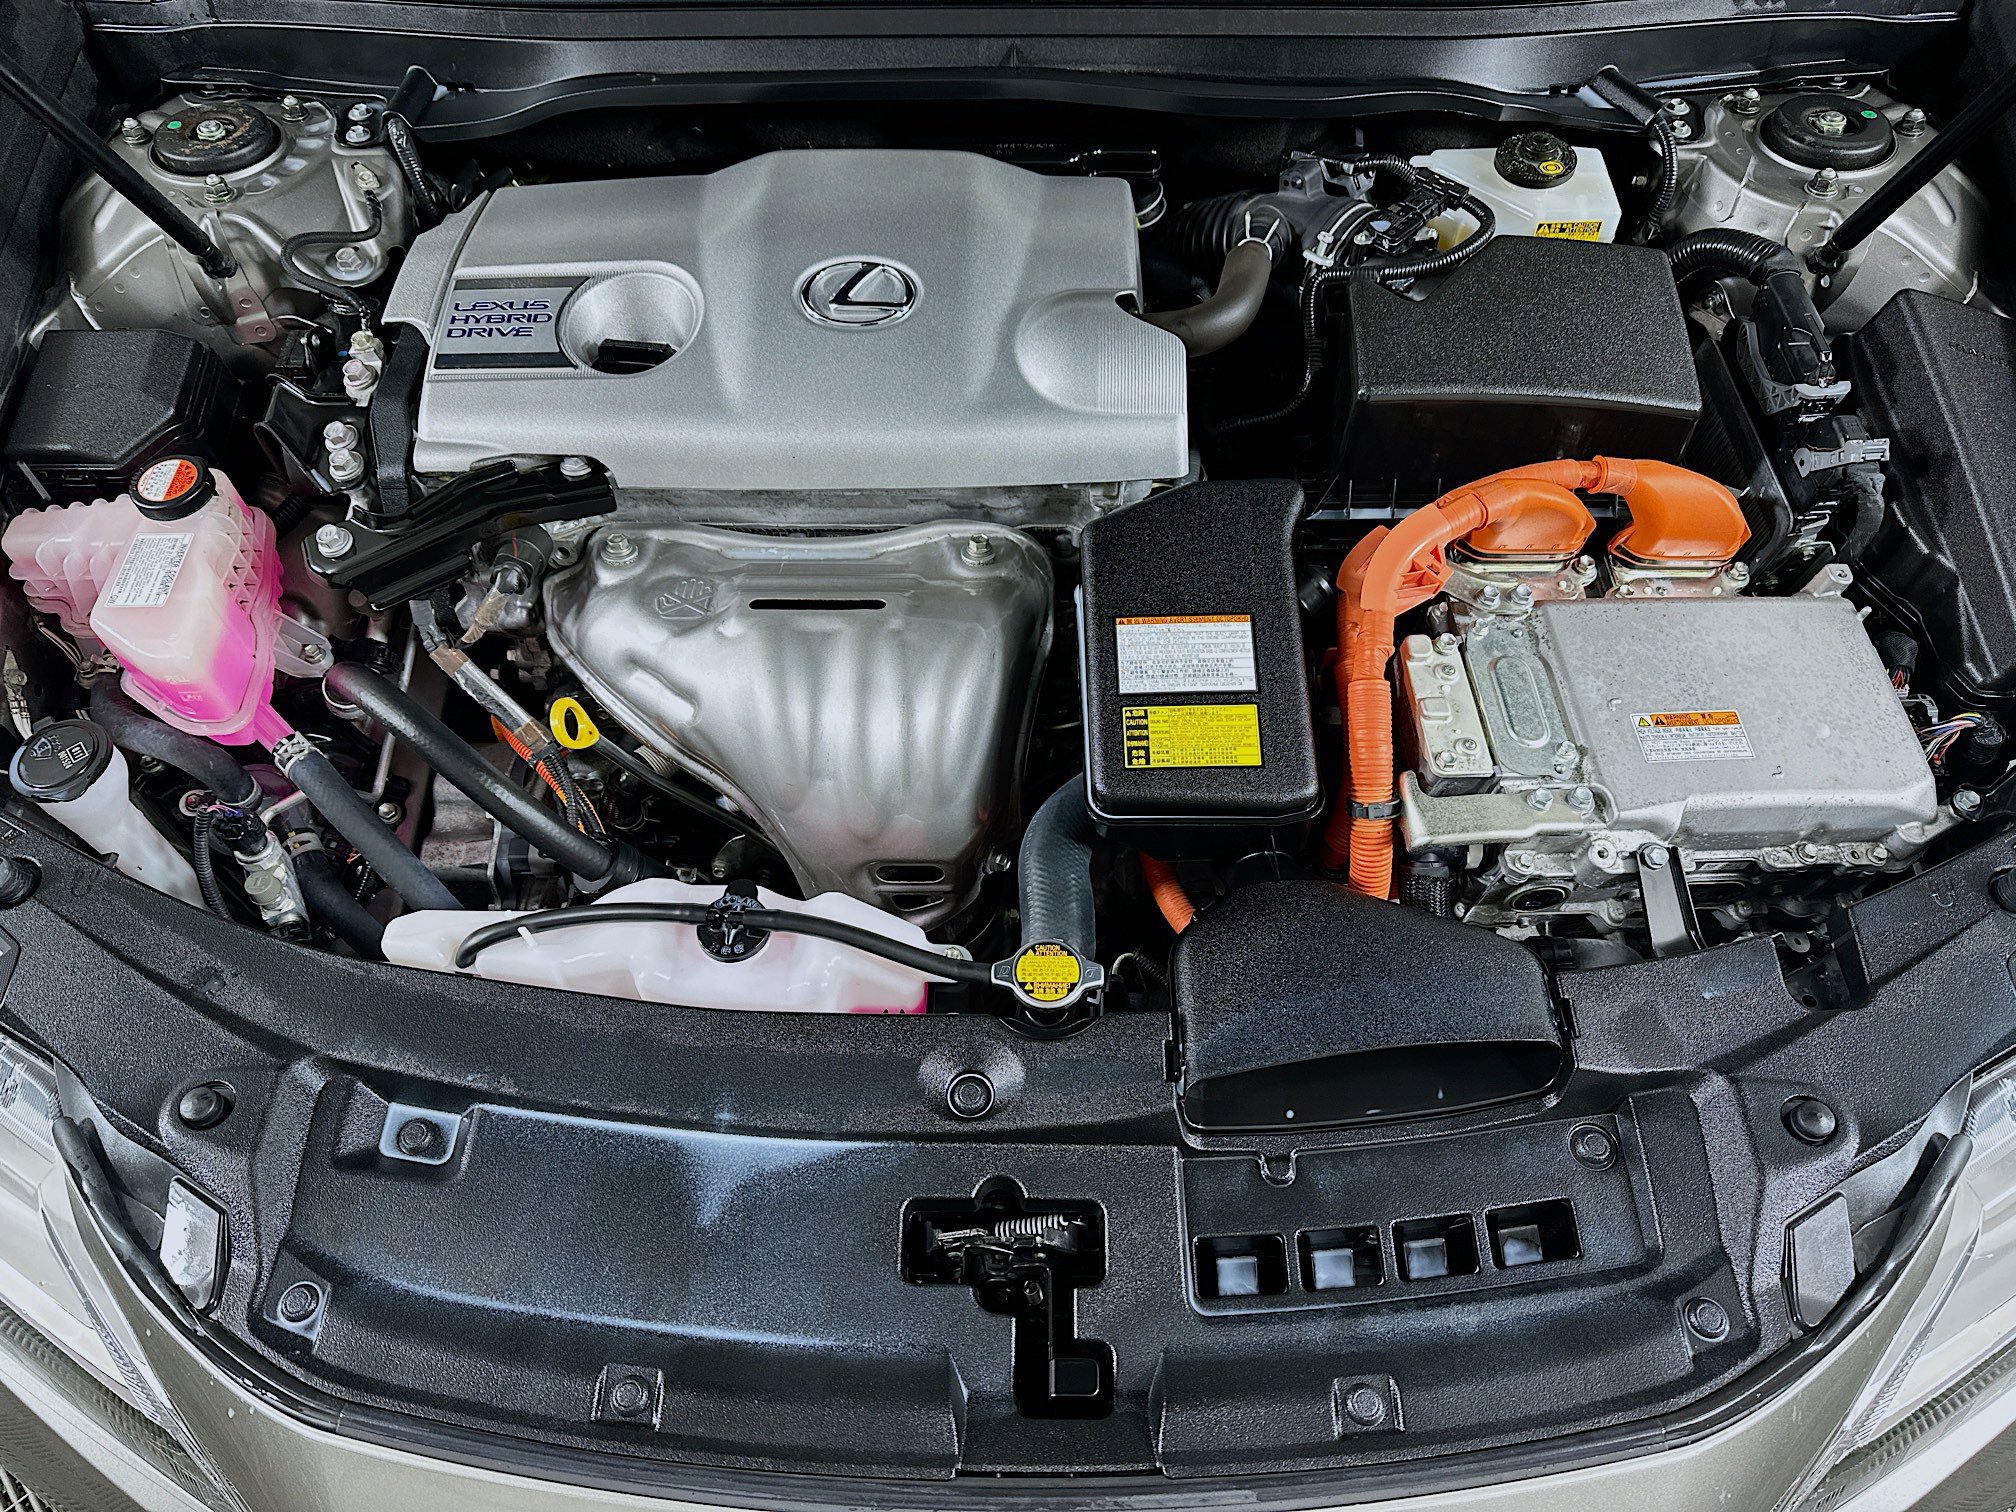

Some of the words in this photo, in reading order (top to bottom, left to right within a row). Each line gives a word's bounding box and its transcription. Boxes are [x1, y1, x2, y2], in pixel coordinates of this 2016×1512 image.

[453, 299, 551, 311] LEXUS
[449, 312, 554, 324] HYBRID
[446, 326, 535, 338] DRIVE
